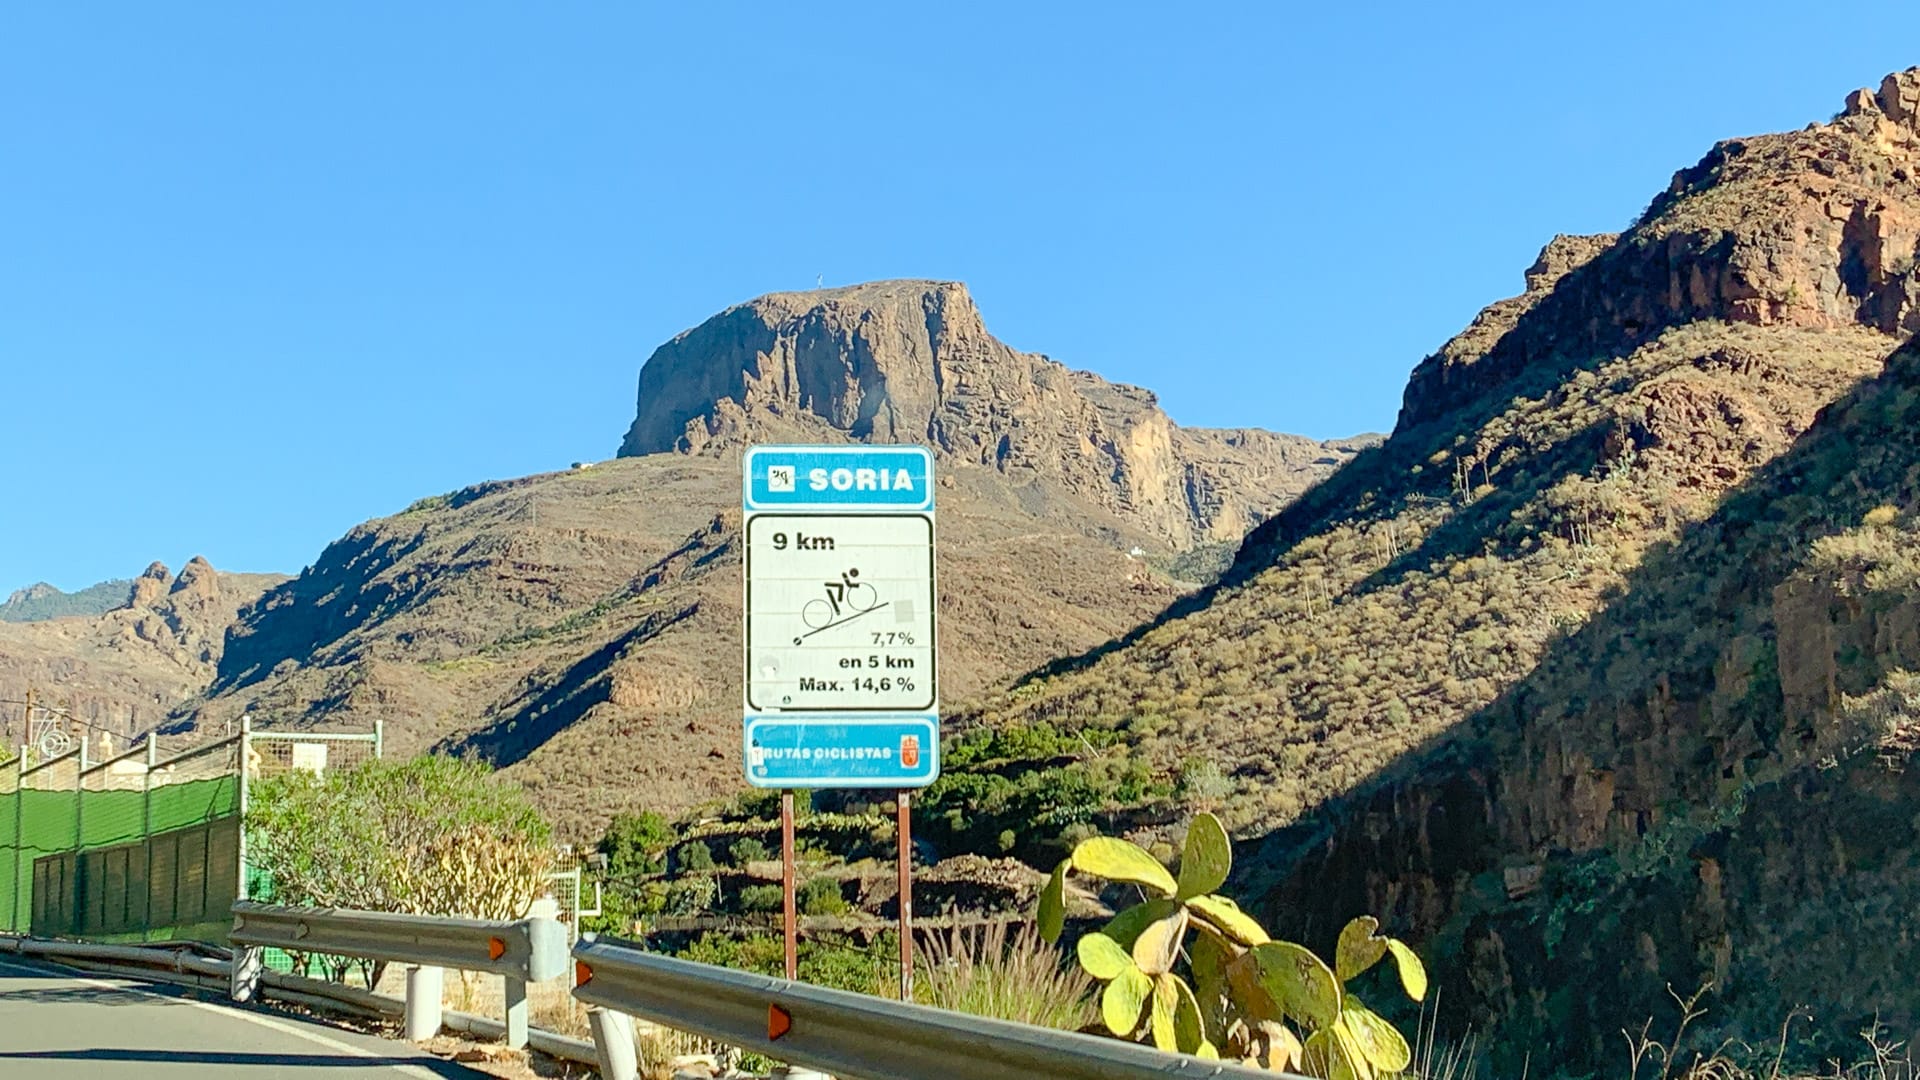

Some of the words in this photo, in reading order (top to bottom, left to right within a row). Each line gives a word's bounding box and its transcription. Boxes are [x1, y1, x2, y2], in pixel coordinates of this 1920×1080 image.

[809, 468, 914, 491] SORIA
[772, 532, 788, 550] 9
[796, 532, 835, 550] km
[839, 657, 862, 669] en
[868, 656, 879, 669] 5
[885, 655, 915, 669] km
[800, 678, 845, 692] Max.
[852, 678, 891, 694] 14,6
[897, 677, 915, 692] %
[763, 747, 811, 760] RUTAS
[814, 747, 892, 760] CICLISTAS
